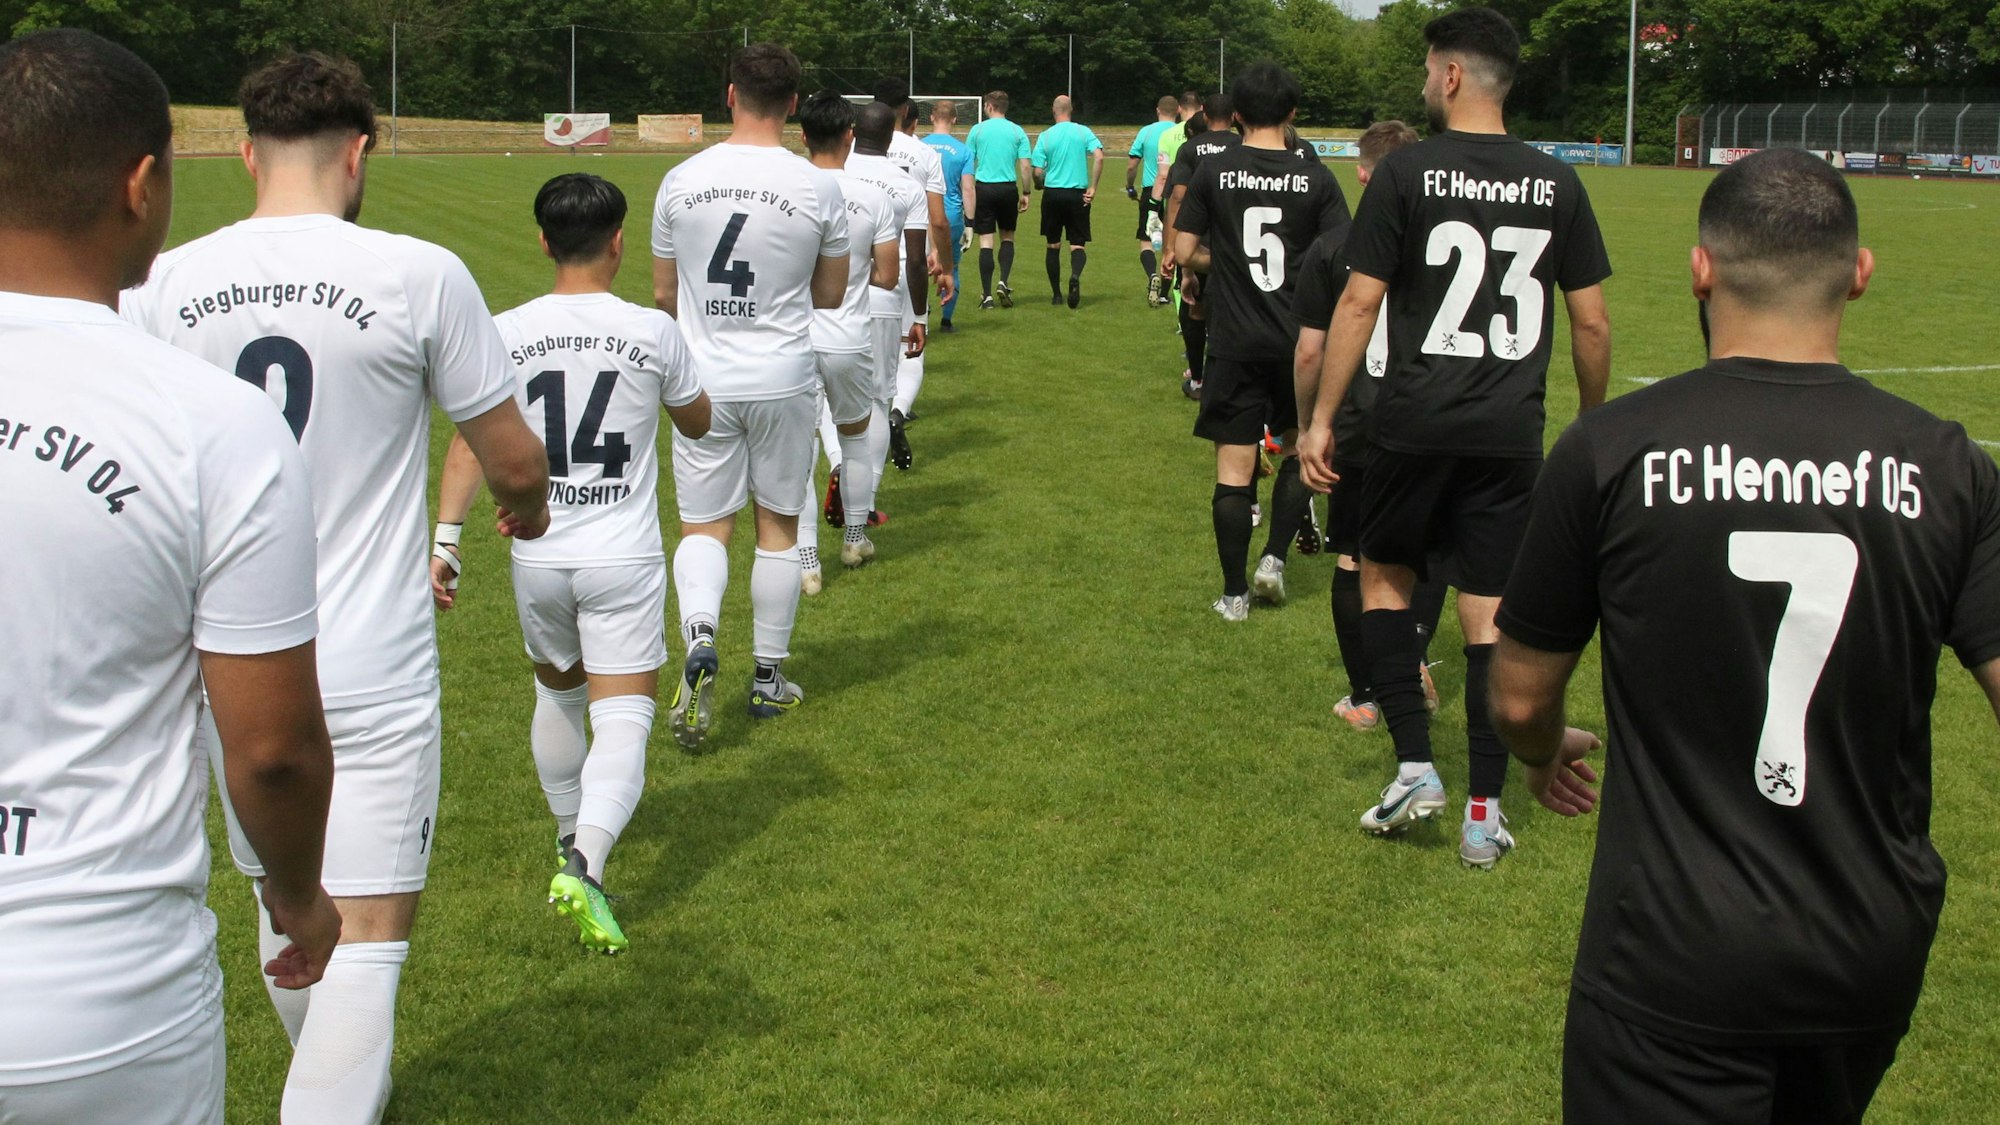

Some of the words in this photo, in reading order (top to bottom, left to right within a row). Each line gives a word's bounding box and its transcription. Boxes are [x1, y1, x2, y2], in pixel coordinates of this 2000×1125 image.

[898, 151, 909, 160] SV
[908, 156, 919, 166] 04
[1196, 144, 1206, 156] FC
[887, 187, 898, 199] 04
[1219, 171, 1236, 190] FC
[1237, 170, 1291, 192] Hennef
[1292, 174, 1309, 193] 05
[1423, 169, 1447, 197] FC
[1450, 170, 1530, 205] Hennef
[1533, 178, 1556, 207] 05
[684, 186, 757, 210] Siegburger
[760, 190, 779, 206] SV
[779, 199, 798, 217] 04
[847, 201, 860, 215] 04
[707, 212, 755, 298] 4
[1243, 206, 1285, 292] 5
[179, 283, 308, 329] Siegburger
[312, 281, 345, 309] SV
[344, 296, 377, 331] 04
[706, 299, 756, 318] ISECKE
[1420, 220, 1552, 361] 23
[511, 335, 600, 366] Siegburger
[604, 336, 627, 355] SV
[629, 346, 650, 369] 04
[526, 370, 631, 478] 14
[35, 425, 95, 473] SV
[87, 459, 141, 515] 04
[1643, 448, 1693, 507] FC
[1703, 443, 1872, 508] Hennef
[1881, 456, 1922, 520] 05
[1728, 530, 1859, 807] 7
[420, 816, 429, 855] 9
